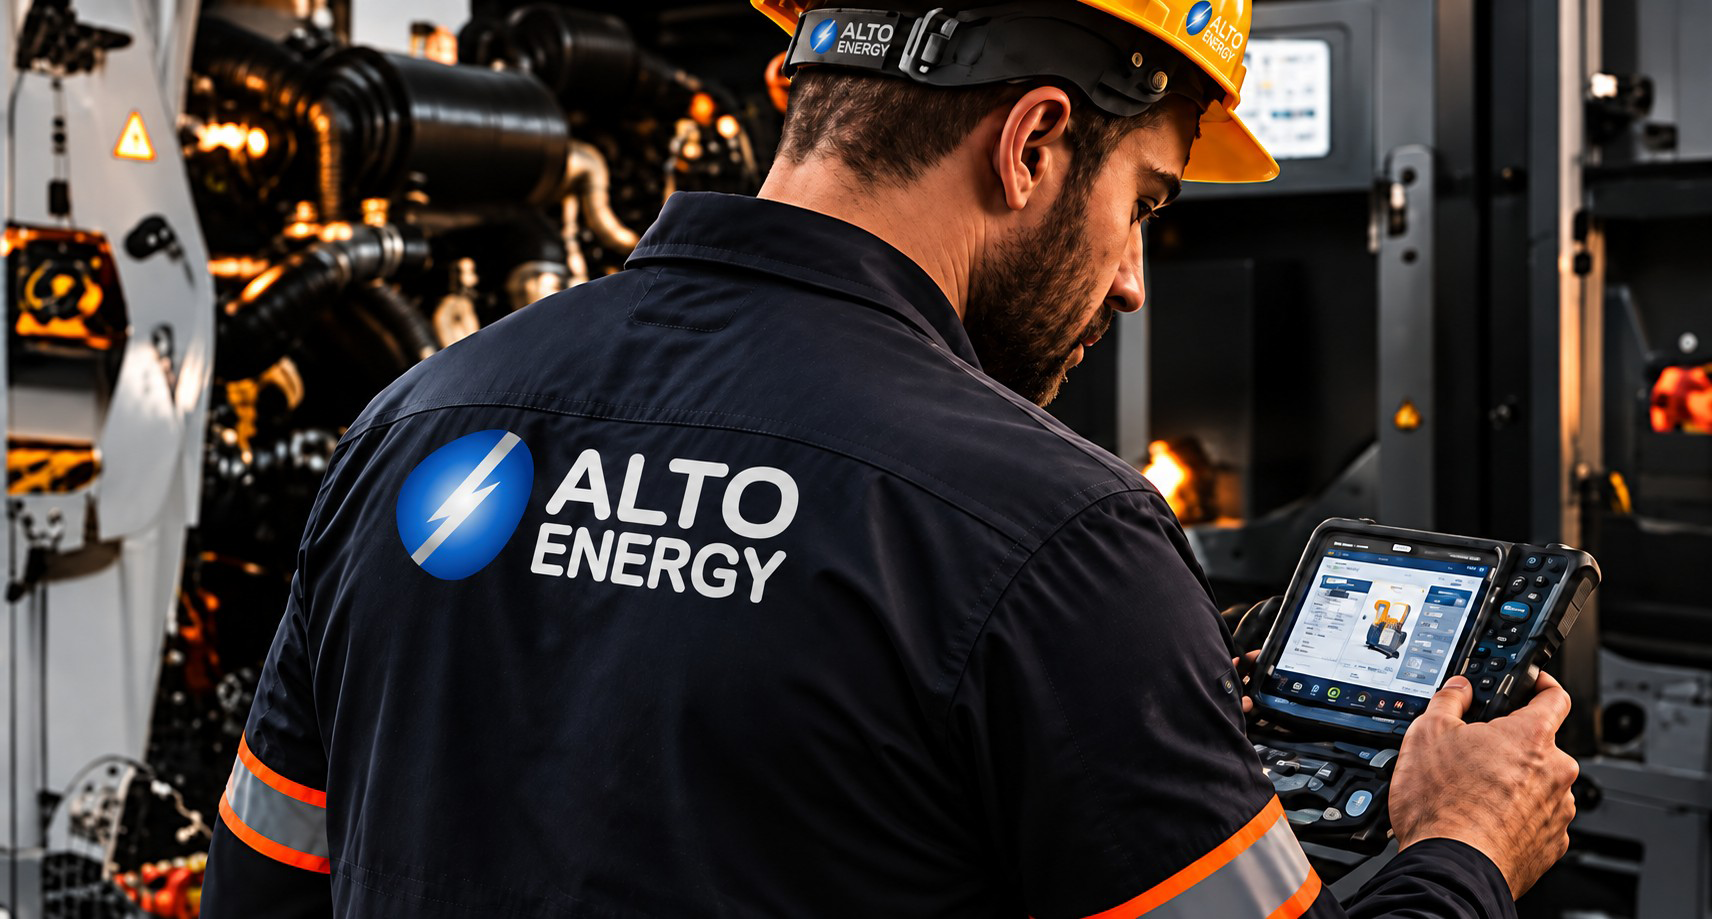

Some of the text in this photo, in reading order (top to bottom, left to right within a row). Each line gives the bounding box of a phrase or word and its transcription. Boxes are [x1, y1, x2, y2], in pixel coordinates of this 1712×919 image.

[837, 40, 891, 57] ENERGY
[840, 22, 894, 43] ALTO
[1202, 29, 1235, 62] ENERGY
[1210, 15, 1243, 49] ALTO
[545, 448, 800, 539] ALTO
[530, 522, 787, 604] ENERGY
